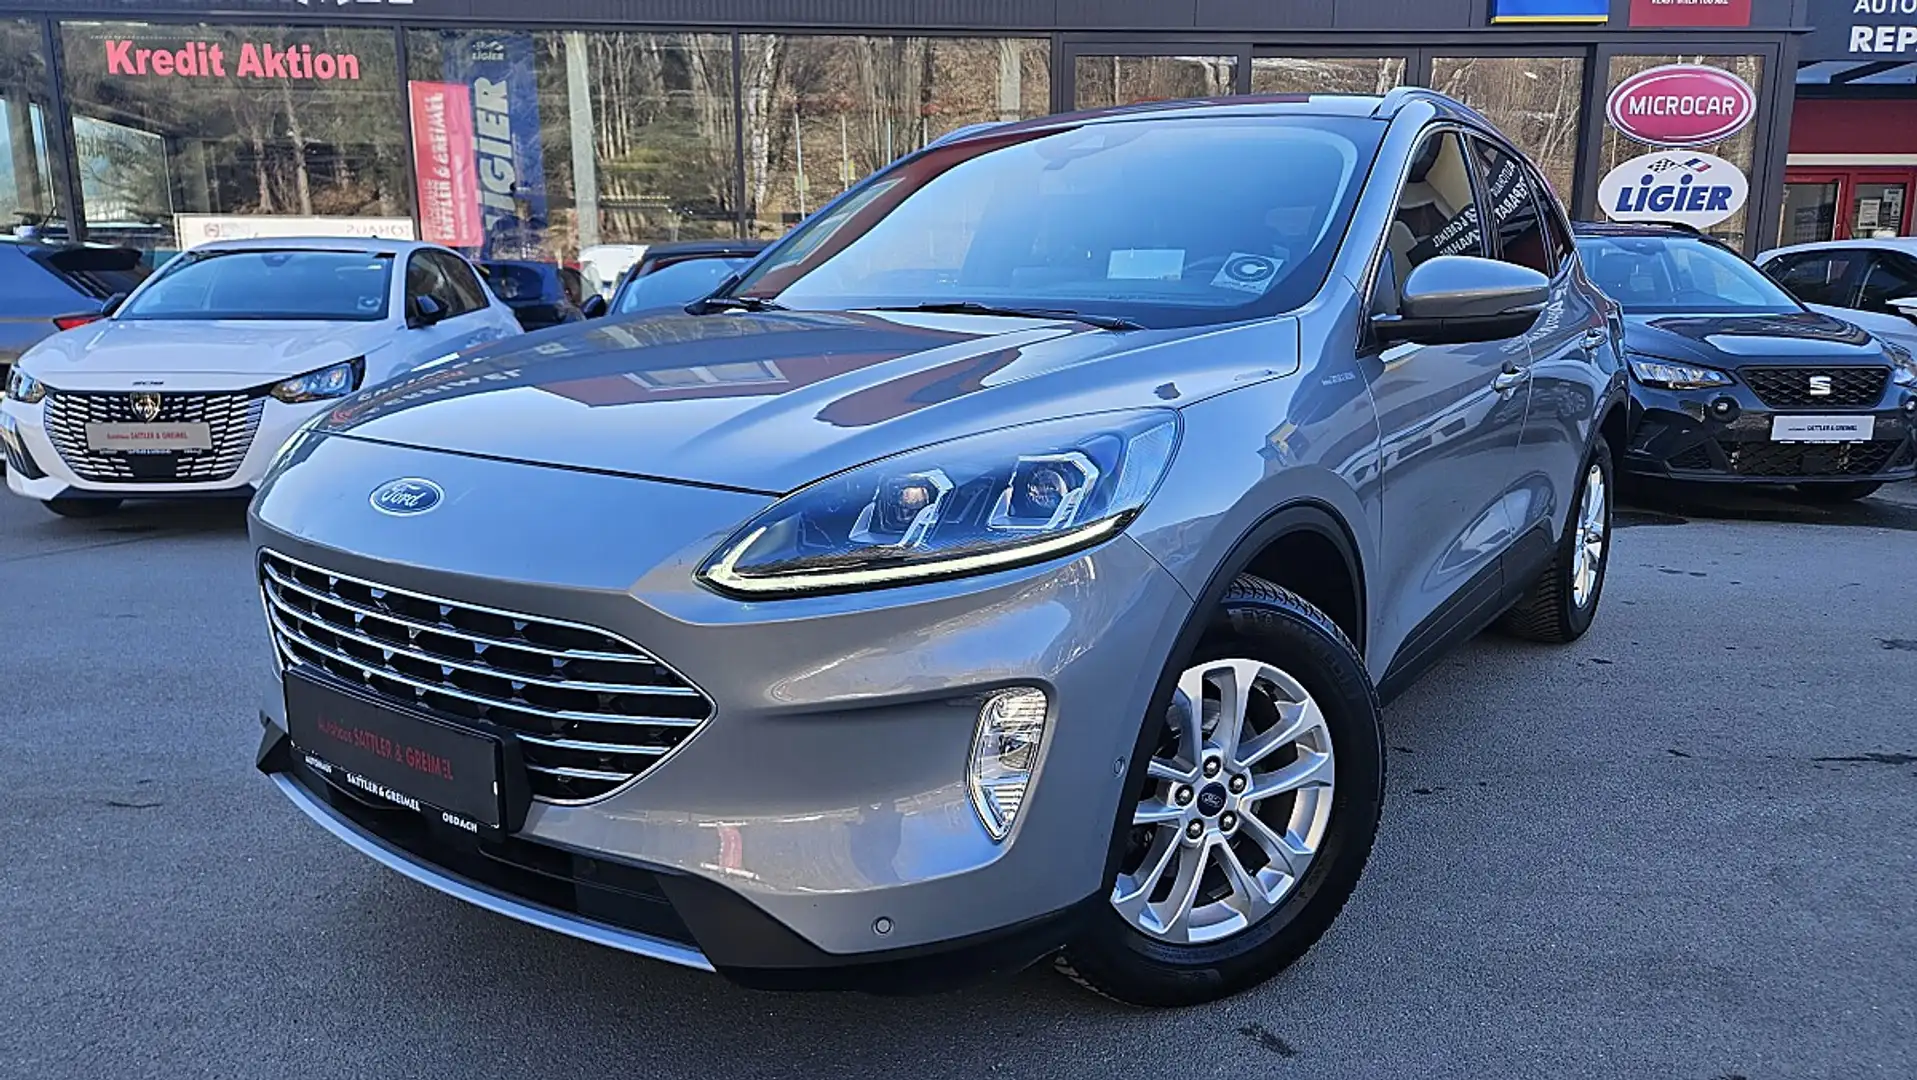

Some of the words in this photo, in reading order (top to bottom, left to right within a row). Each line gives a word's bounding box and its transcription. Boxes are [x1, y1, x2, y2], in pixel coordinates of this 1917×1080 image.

[1848, 25, 1917, 53] REP
[105, 39, 225, 77] Kredit
[236, 43, 360, 80] Aktion
[1628, 95, 1735, 115] MICROCAR
[381, 483, 427, 507] Ford
[353, 728, 393, 759] SATTLER
[394, 743, 403, 763] &
[405, 748, 453, 780] GREIMEL
[346, 773, 379, 798] SATTLER
[442, 812, 478, 834] OBDACH
